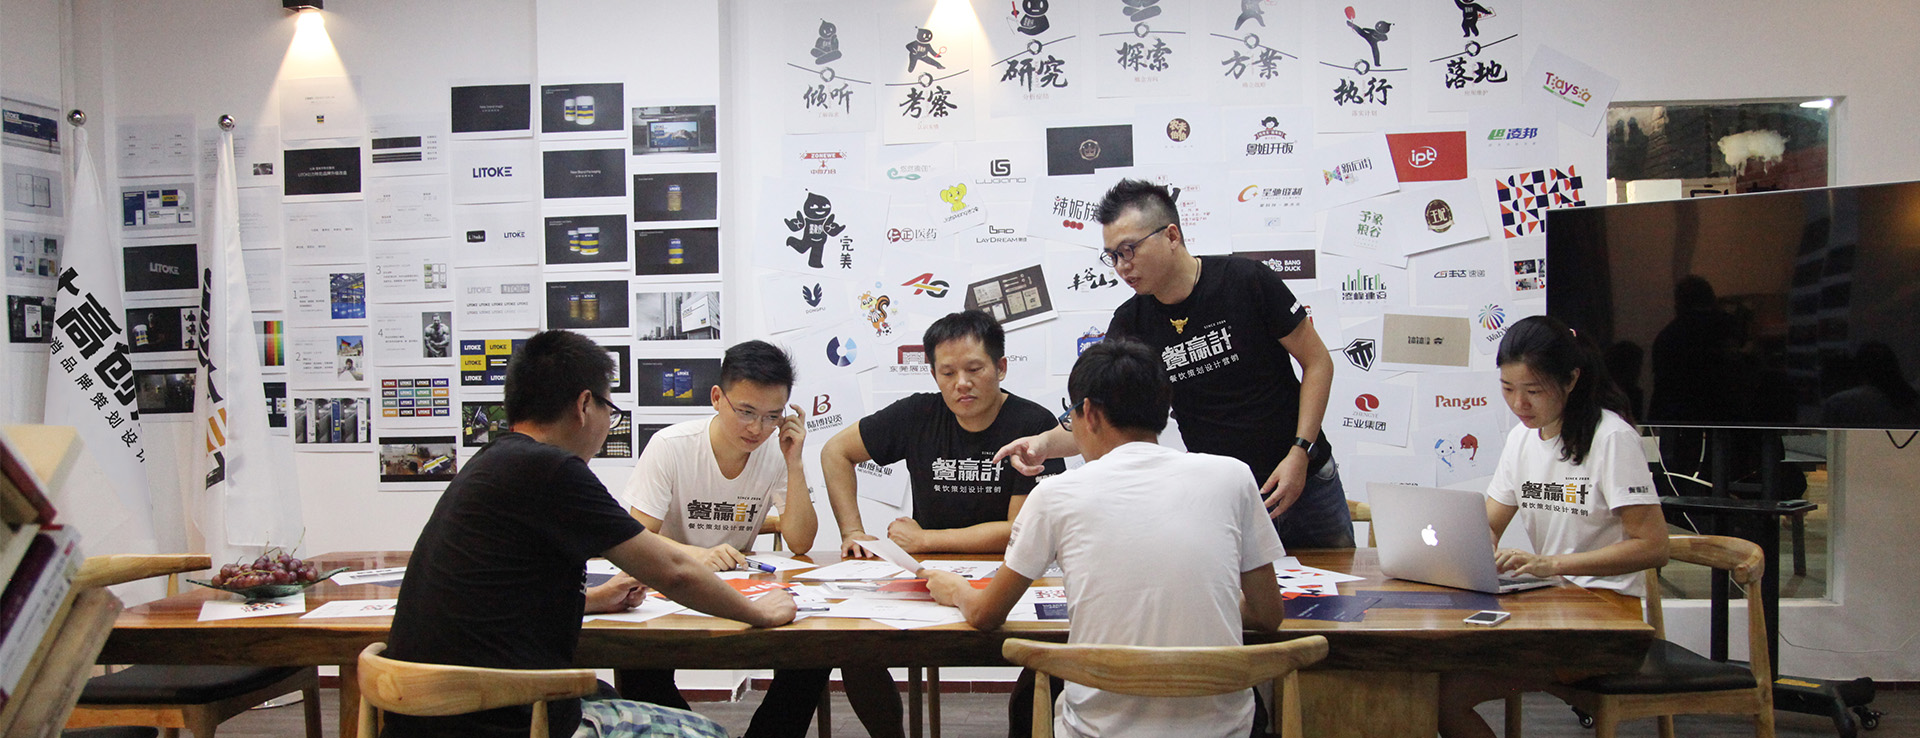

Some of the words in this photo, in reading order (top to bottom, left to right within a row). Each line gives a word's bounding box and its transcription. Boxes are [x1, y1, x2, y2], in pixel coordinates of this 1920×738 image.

[1115, 37, 1172, 72] 探索
[1000, 55, 1068, 92] 研究
[1445, 57, 1508, 89] 落地
[803, 84, 854, 114] 倾听
[899, 86, 957, 119] 考察
[1333, 77, 1393, 106] 执行
[1506, 127, 1538, 140] 凌邦
[1411, 149, 1436, 165] ipt
[472, 166, 512, 178] LITOKE
[840, 236, 854, 269] 完美
[150, 262, 180, 275] LITOKE
[57, 267, 139, 420] 高创
[1435, 395, 1487, 410] Pangus
[1343, 417, 1386, 431] 正业集团
